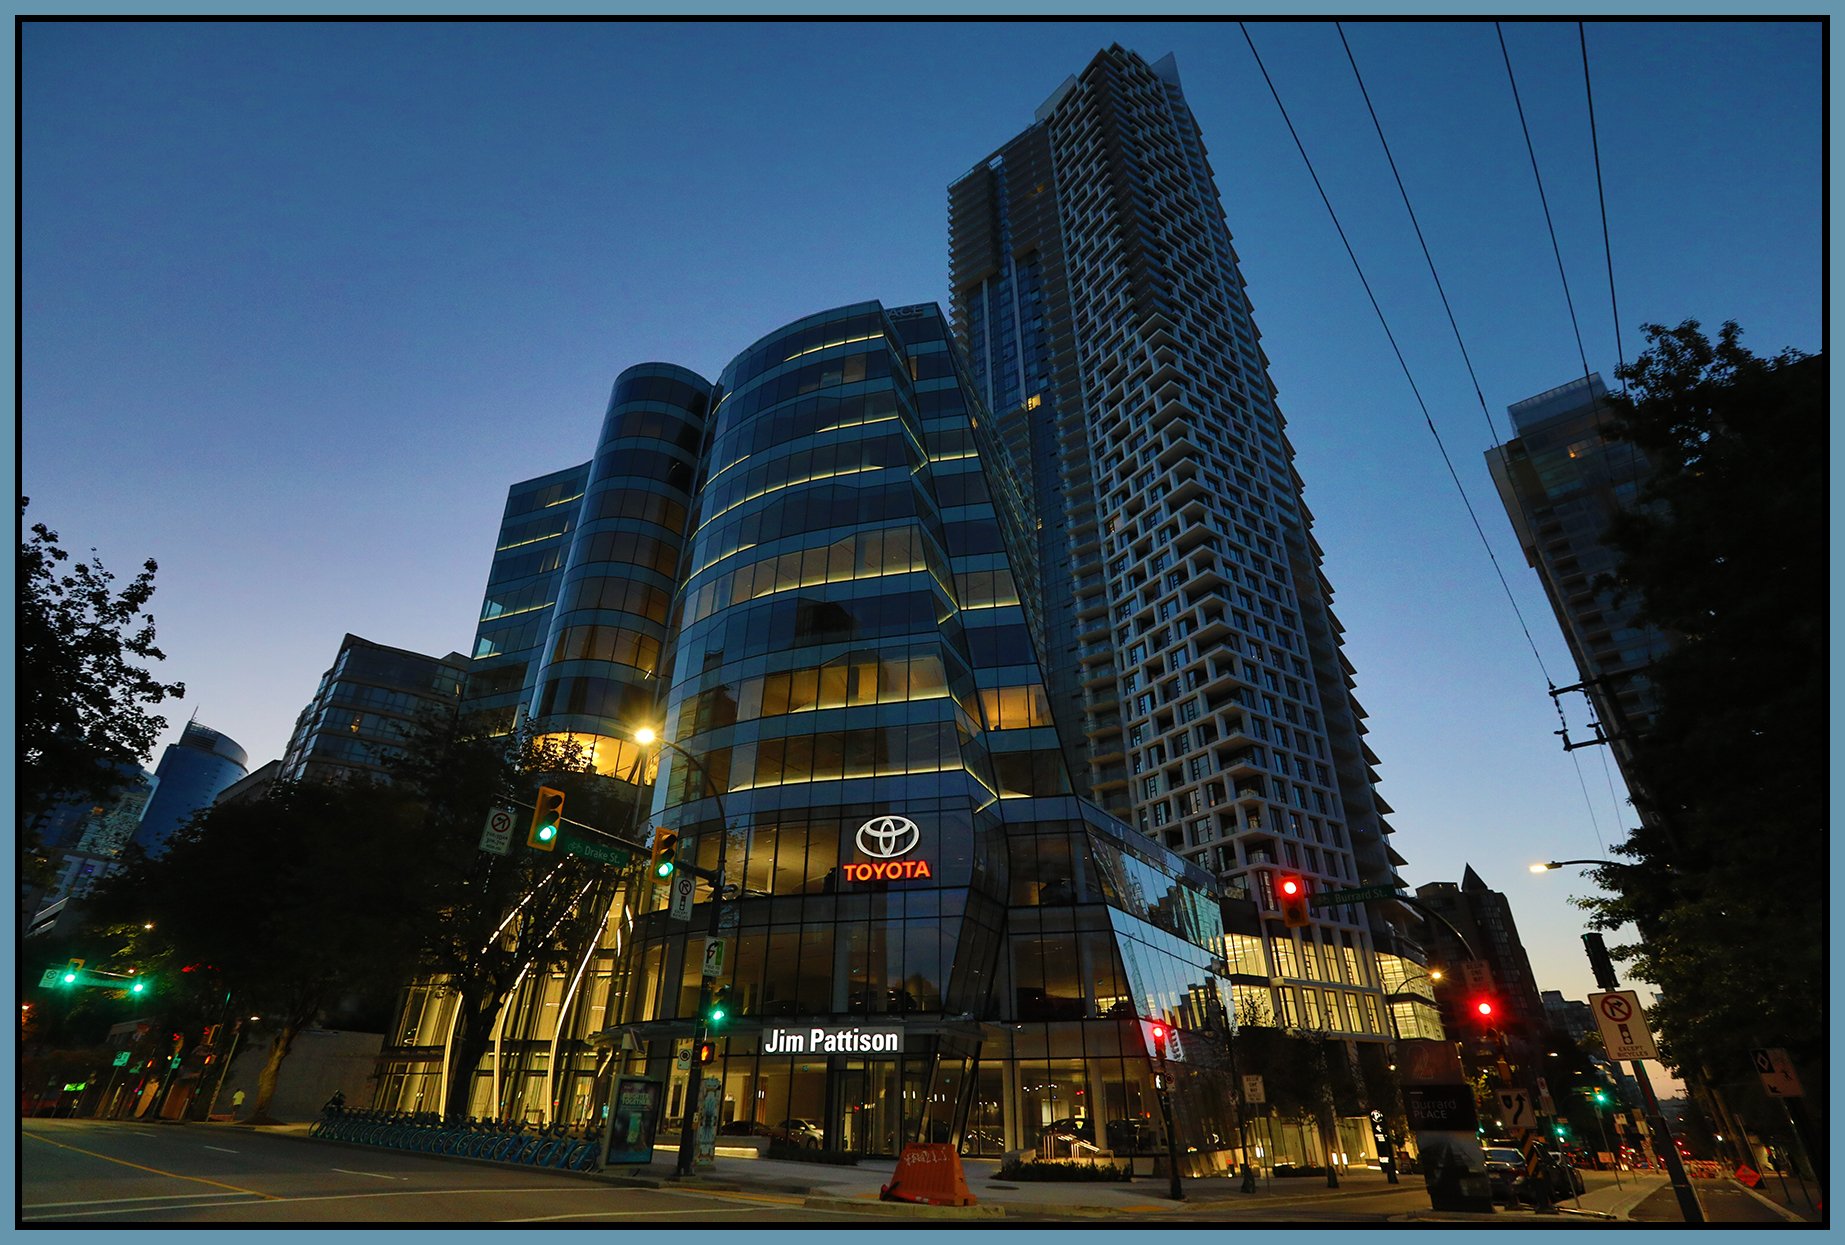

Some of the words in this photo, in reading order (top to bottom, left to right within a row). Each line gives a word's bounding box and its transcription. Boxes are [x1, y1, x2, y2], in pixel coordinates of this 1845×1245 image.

[584, 845, 609, 860] Drake
[842, 860, 932, 882] TOYOTA
[1335, 889, 1371, 903] Burrard
[764, 1028, 804, 1053] Jim
[810, 1028, 898, 1053] Pattison
[1413, 1110, 1447, 1119] PLACE
